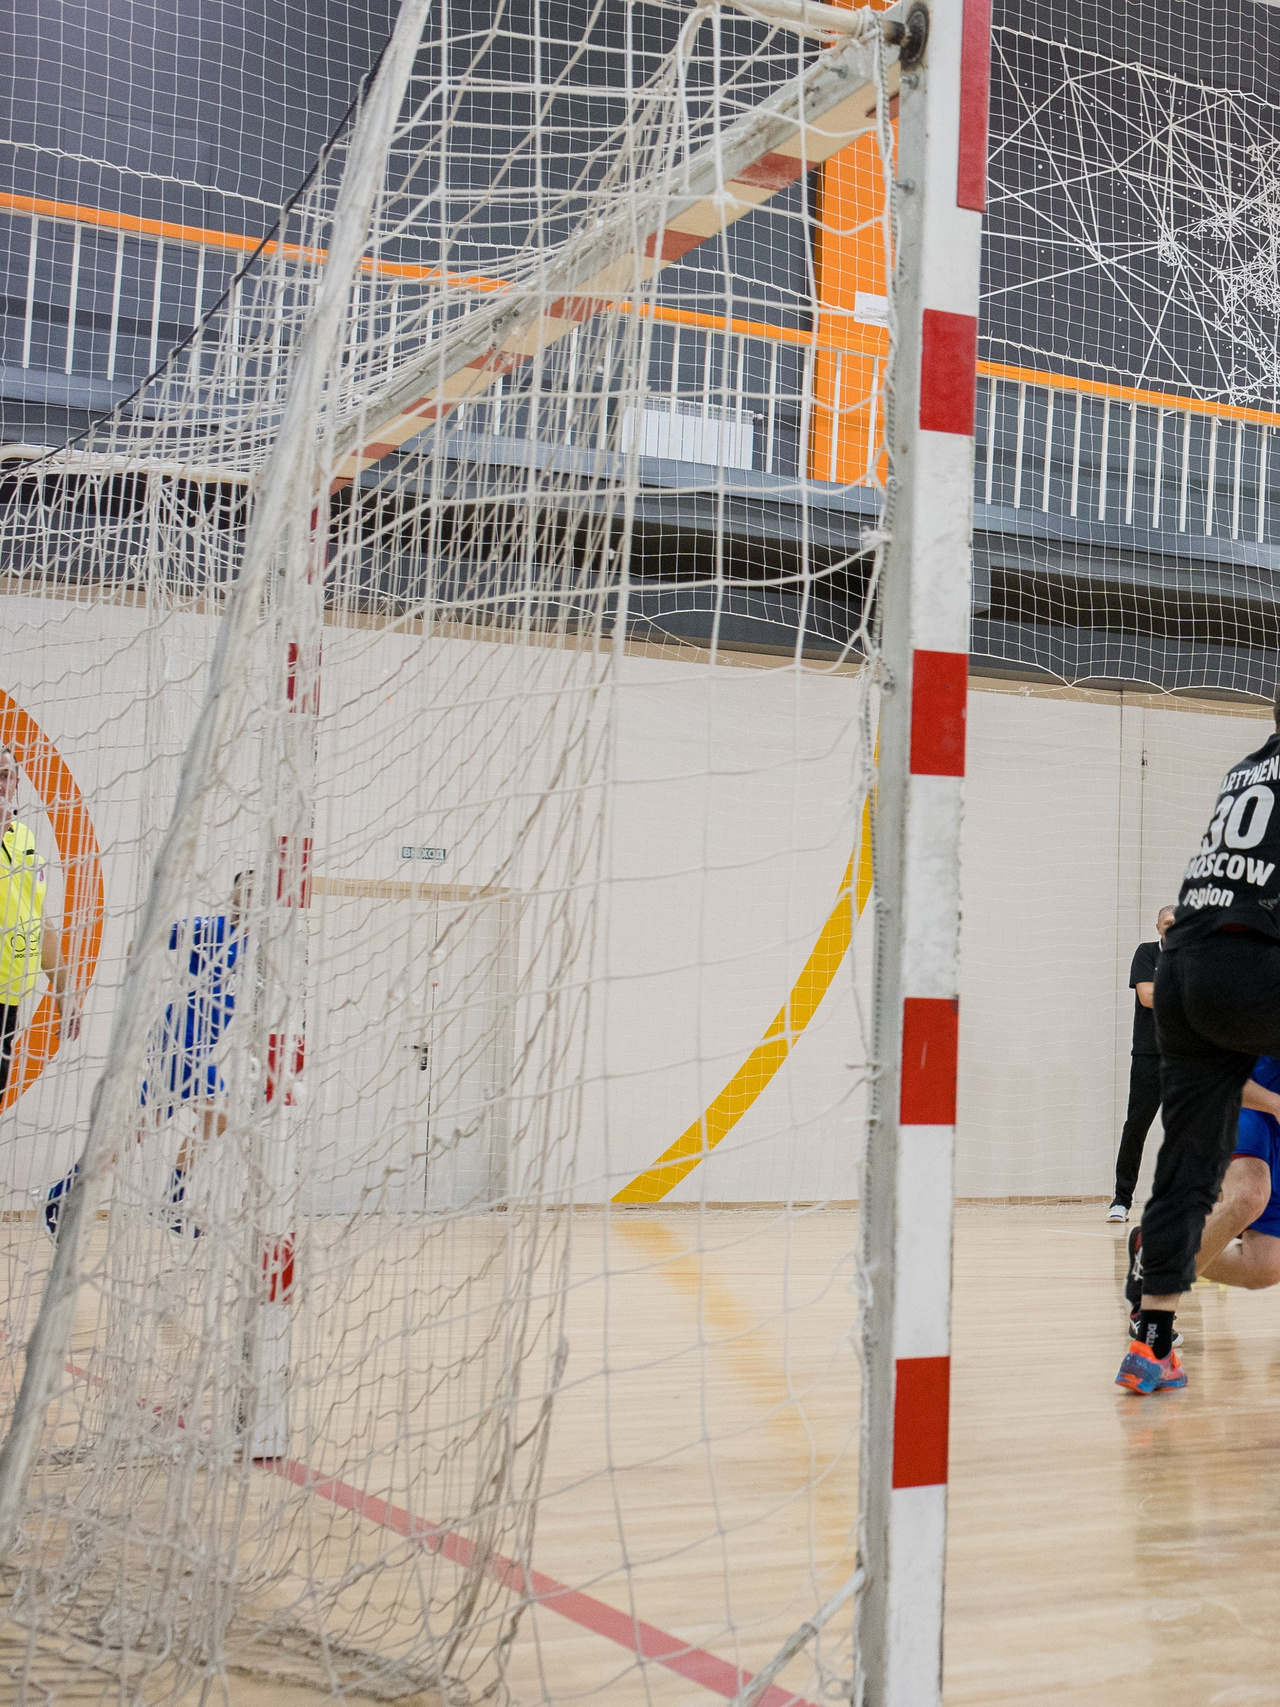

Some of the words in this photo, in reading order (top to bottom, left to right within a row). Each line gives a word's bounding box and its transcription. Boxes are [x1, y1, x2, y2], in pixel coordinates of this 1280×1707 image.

[1201, 784, 1275, 856] 30
[402, 847, 445, 860] ВХОД
[1182, 883, 1235, 910] region
